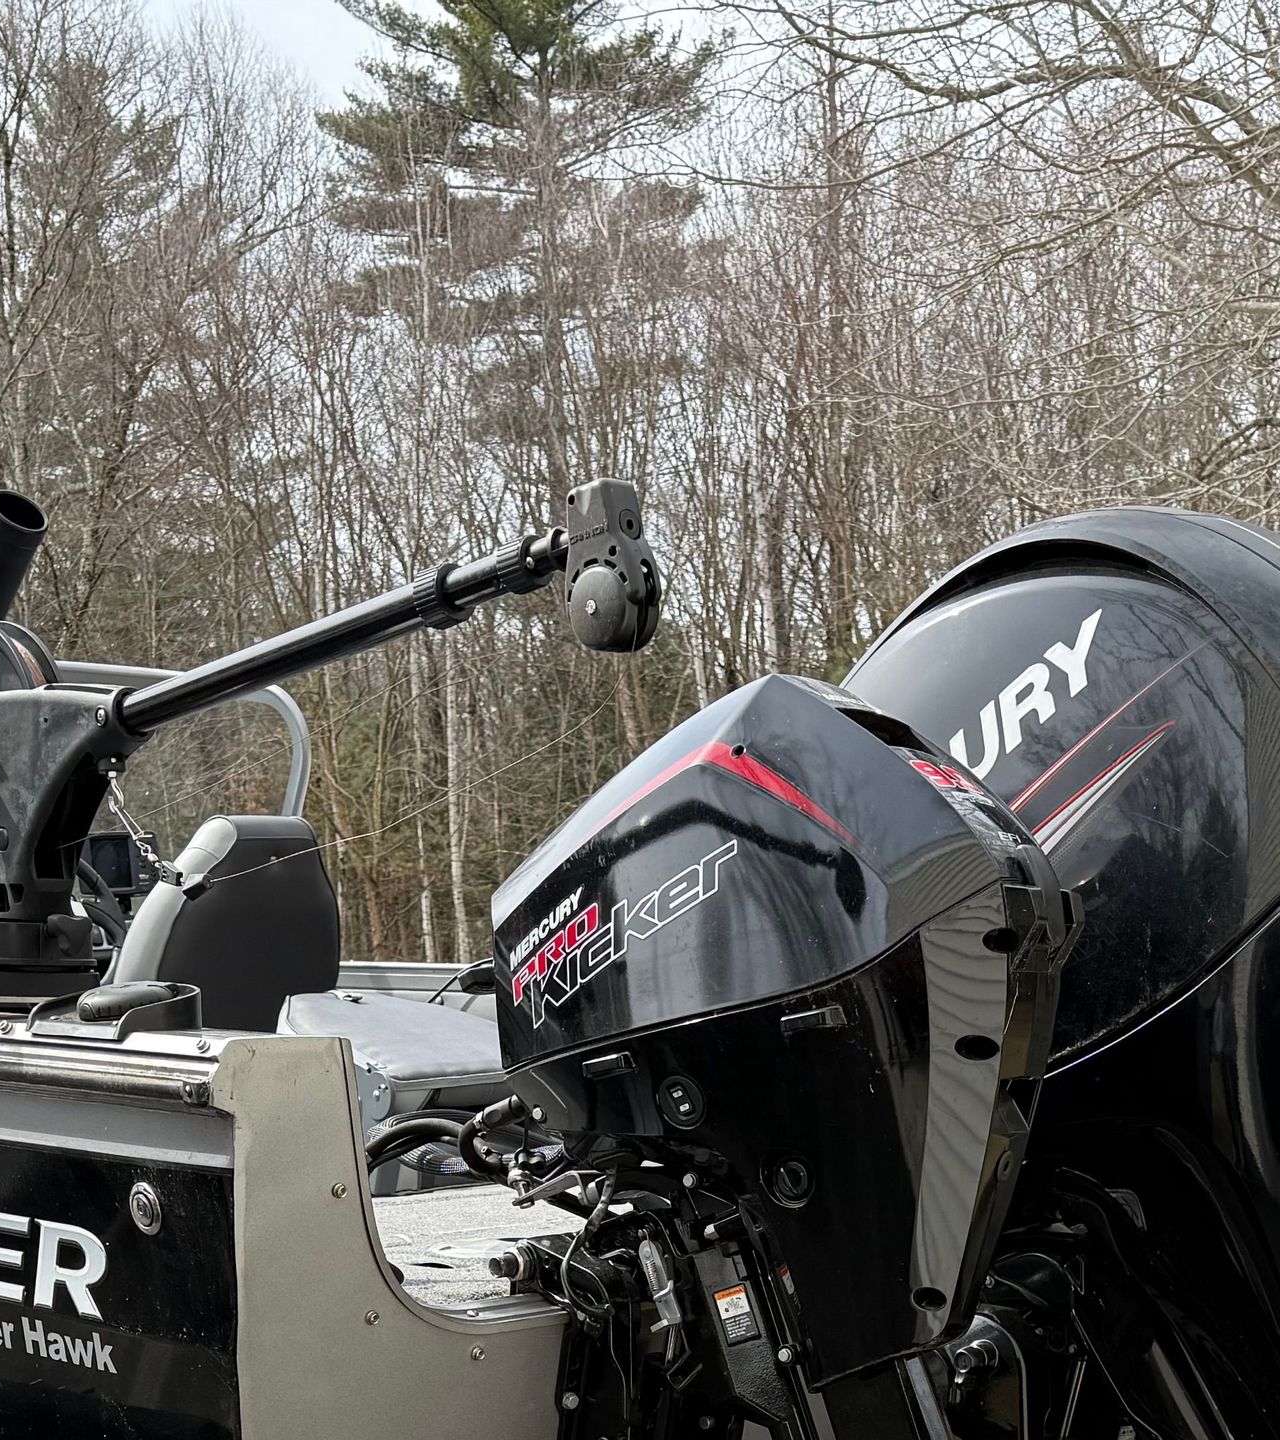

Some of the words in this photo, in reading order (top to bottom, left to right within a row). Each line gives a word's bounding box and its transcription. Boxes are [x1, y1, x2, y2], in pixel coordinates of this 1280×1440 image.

[510, 883, 585, 972] MERCURY
[512, 902, 599, 1008] PRO
[21, 1316, 118, 1374] Hawk
